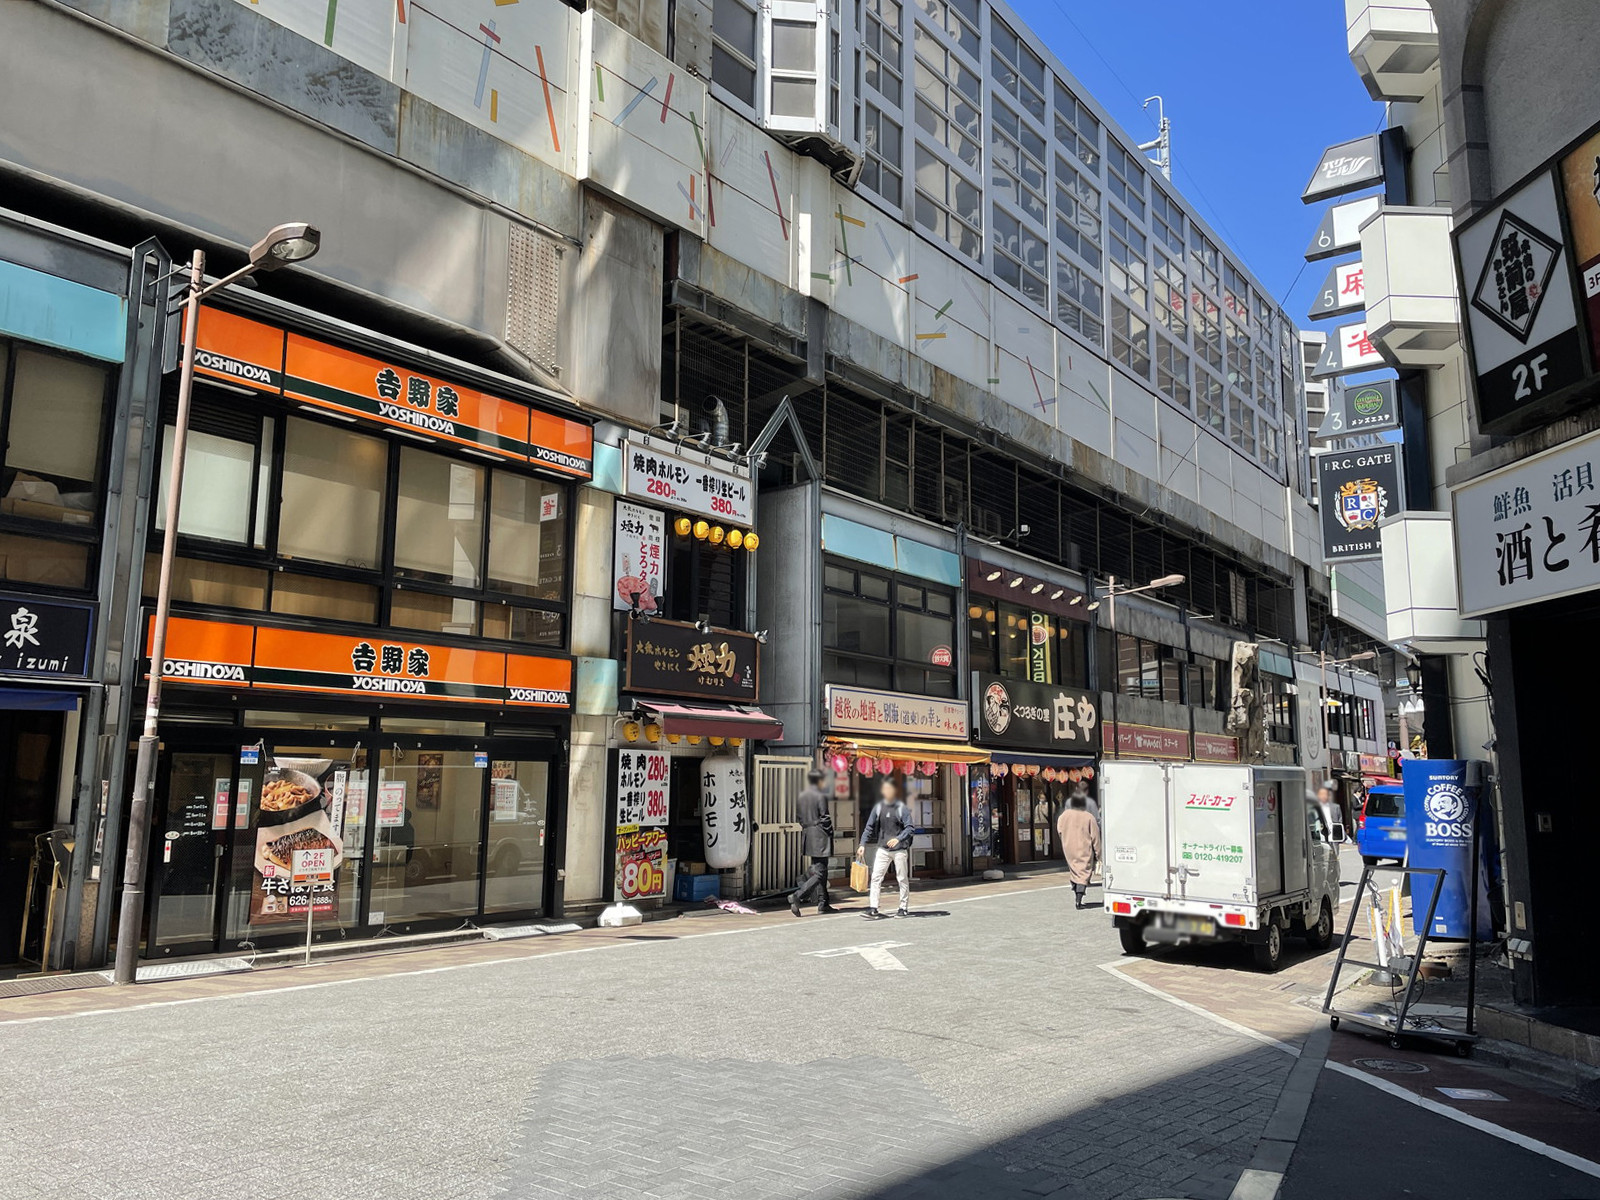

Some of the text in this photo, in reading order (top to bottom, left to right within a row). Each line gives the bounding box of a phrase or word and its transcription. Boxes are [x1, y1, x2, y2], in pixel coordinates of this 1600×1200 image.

[1318, 230, 1331, 248] 6
[1324, 289, 1334, 308] 5
[194, 351, 271, 383] YOSHINOYA
[1326, 349, 1338, 368] 4
[1511, 352, 1549, 401] 2F
[375, 367, 460, 418] 吉野家
[379, 403, 455, 435] YOSHINOYA
[1331, 412, 1343, 430] 3
[1351, 414, 1390, 426] メンズエステ
[536, 448, 587, 471] YOSHINOYA
[1332, 460, 1354, 471] R.C.
[1357, 453, 1393, 467] GATE
[633, 453, 746, 502] 焼肉ホルモン 一番搾り生ビール
[1493, 462, 1595, 522] 鮮魚 活貝
[1347, 498, 1358, 509] R
[1363, 509, 1374, 520] C
[1332, 542, 1371, 553] BRITISH
[639, 541, 648, 595] とろタン
[649, 544, 660, 576] 煙力
[4, 607, 40, 649] 泉
[17, 652, 69, 672] izumi
[351, 642, 430, 677] 吉野家
[654, 659, 680, 672] やきにく
[687, 642, 736, 678] 煙力
[152, 660, 245, 680] OSHINOYA
[352, 676, 426, 694] YOSHINOYA
[510, 688, 568, 703] YOSHINOYA
[1013, 692, 1096, 742] くつろぎの里 庄や
[620, 753, 647, 771] 焼肉
[620, 771, 647, 788] ホルモン
[1427, 783, 1464, 796] COFFEE
[620, 791, 646, 807] 一番搾り
[1186, 793, 1238, 807] スーパーカーゴ
[620, 807, 645, 824] 生ビール
[703, 771, 719, 848] ホルモン
[1425, 822, 1473, 837] BOSS
[617, 831, 666, 850] ハッピーアワー
[1182, 843, 1243, 853] オーナードライバー募集
[301, 860, 325, 868] OPEN
[1194, 852, 1244, 863] 0120-419207
[624, 862, 663, 893] 80円
[289, 895, 307, 906] 626
